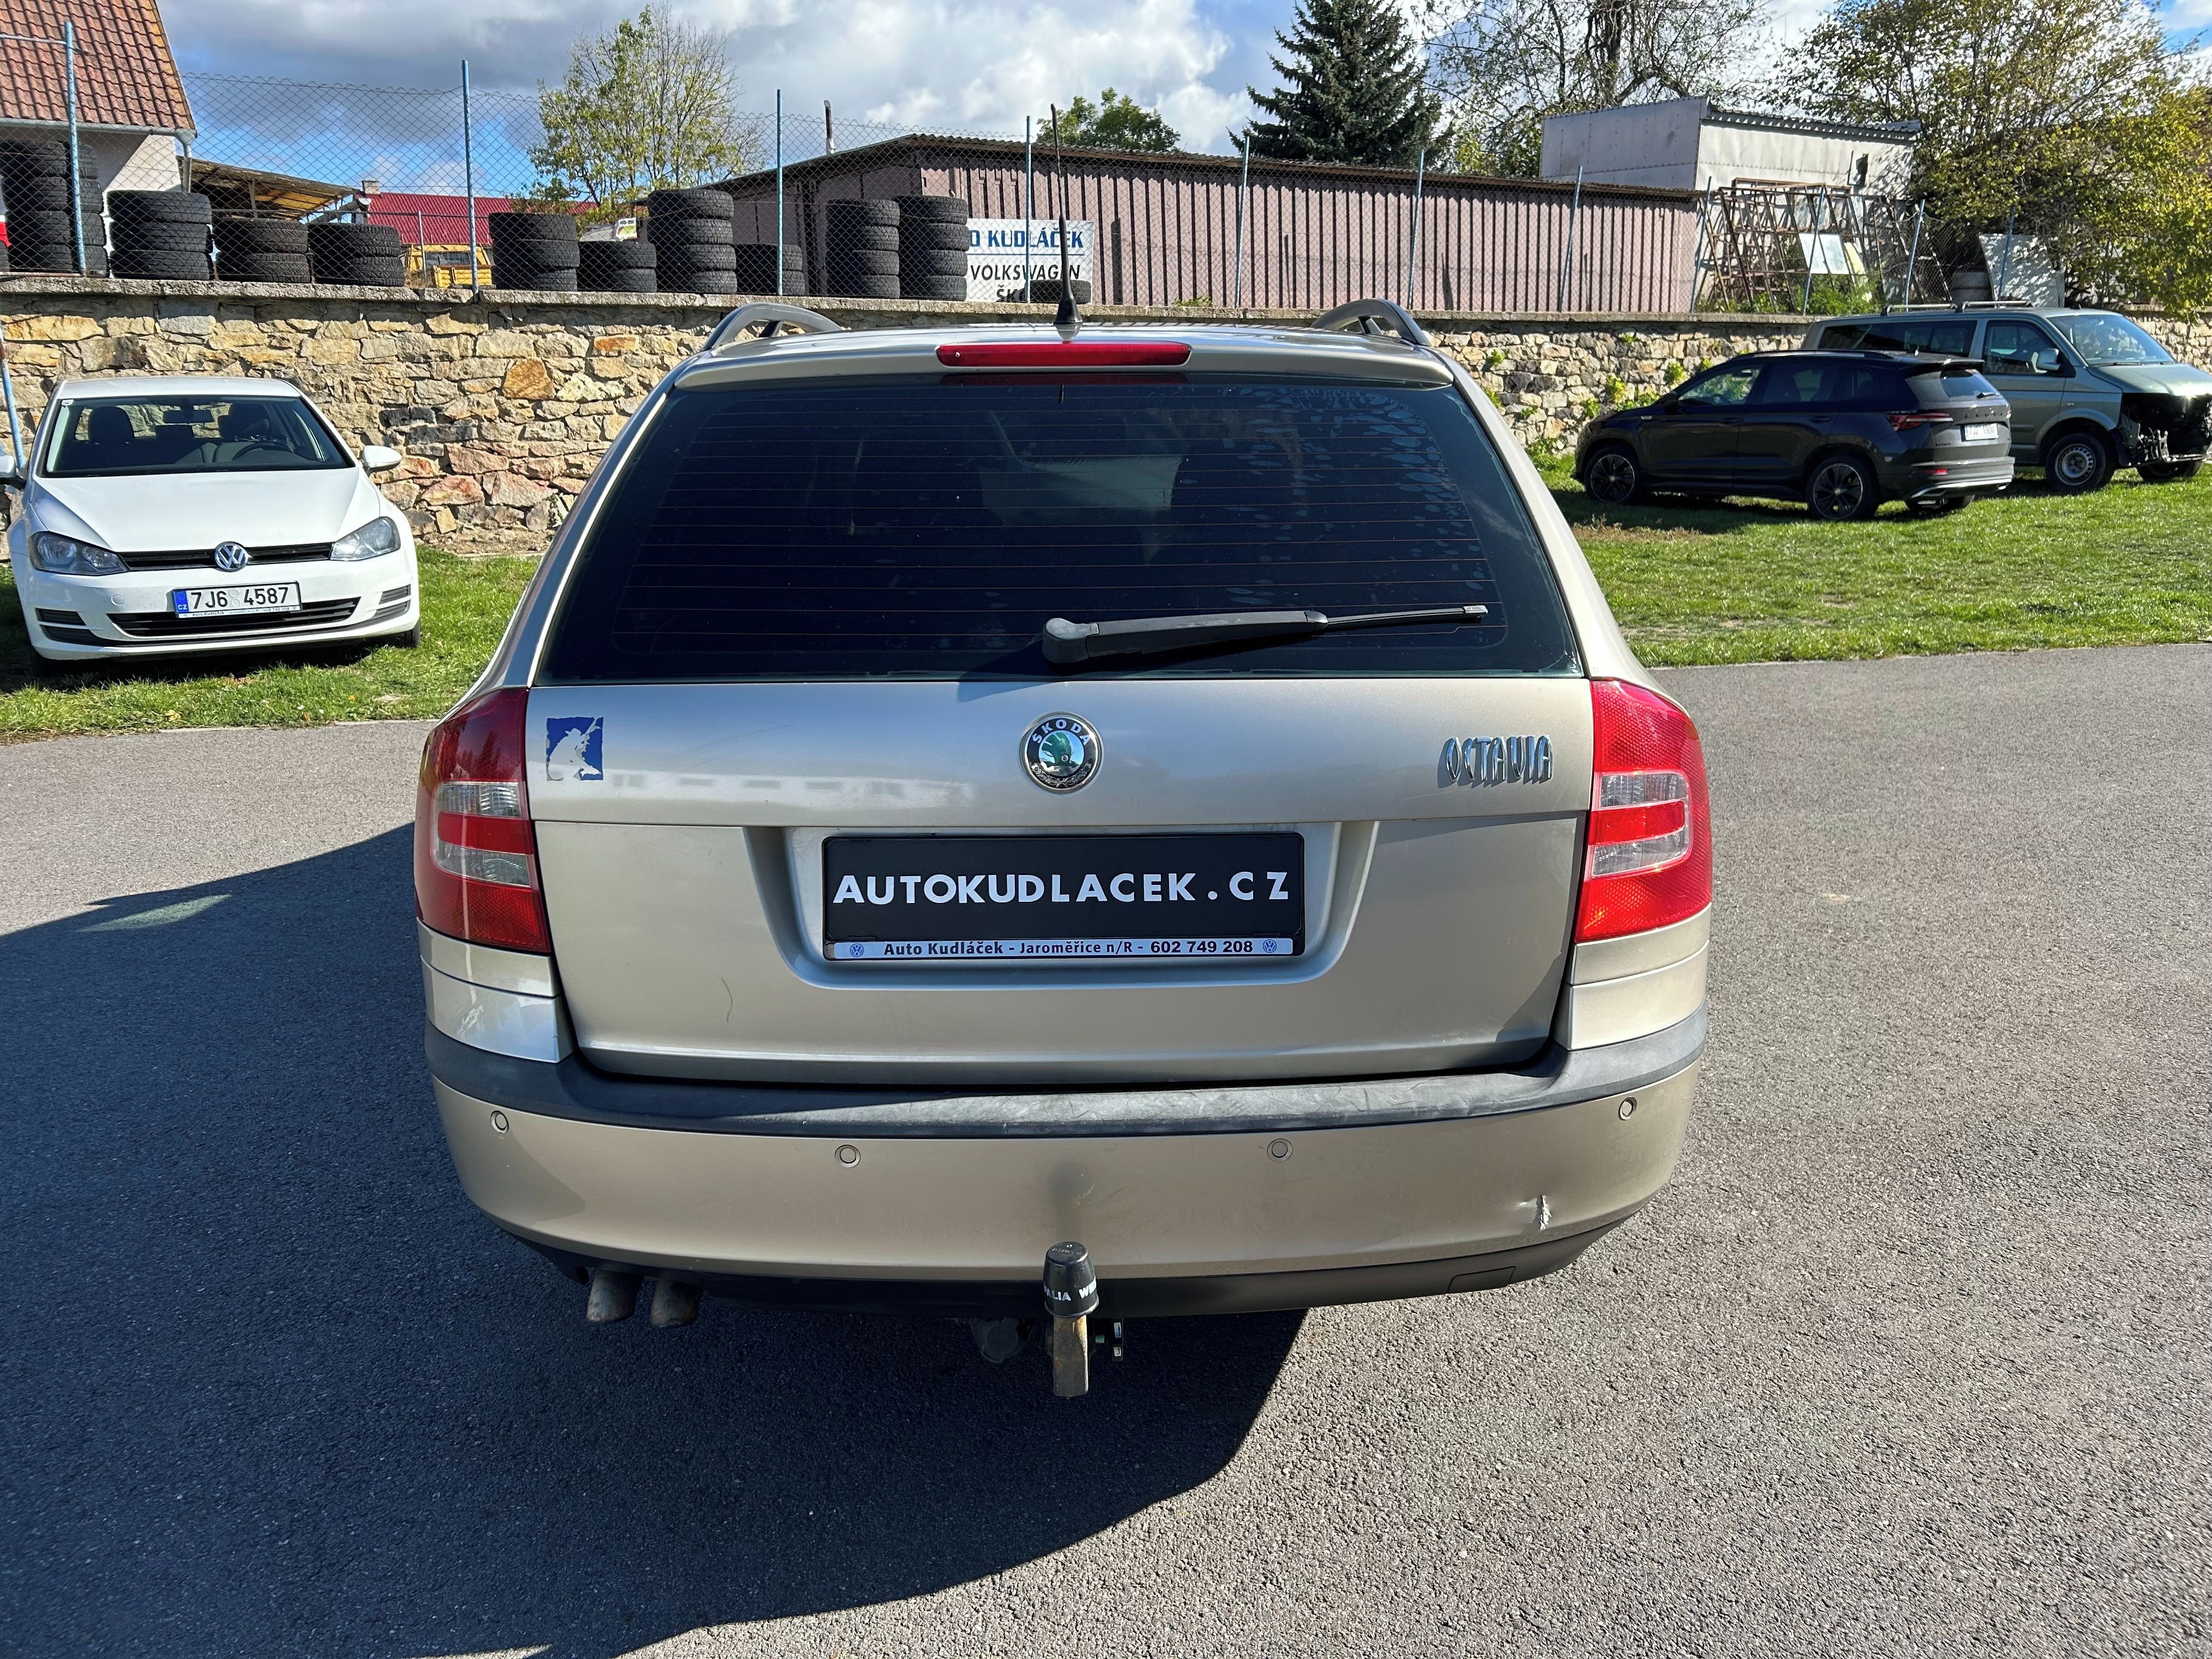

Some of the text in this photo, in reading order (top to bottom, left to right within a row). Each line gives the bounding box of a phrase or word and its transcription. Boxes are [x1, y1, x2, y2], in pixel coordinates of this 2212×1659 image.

[970, 264, 1081, 281] VOLKSWAGN
[996, 284, 1018, 300] ŠK
[190, 590, 228, 609] 7J6
[244, 586, 289, 606] 4587
[1446, 735, 1554, 782] OCTAVIA
[884, 943, 922, 956] Auto
[928, 941, 1003, 955] Kudláček
[1020, 940, 1101, 955] Jaroměřice
[1106, 941, 1133, 955] n/R
[1150, 940, 1181, 953] 602
[1187, 940, 1217, 953] 749
[1222, 940, 1254, 953] 208
